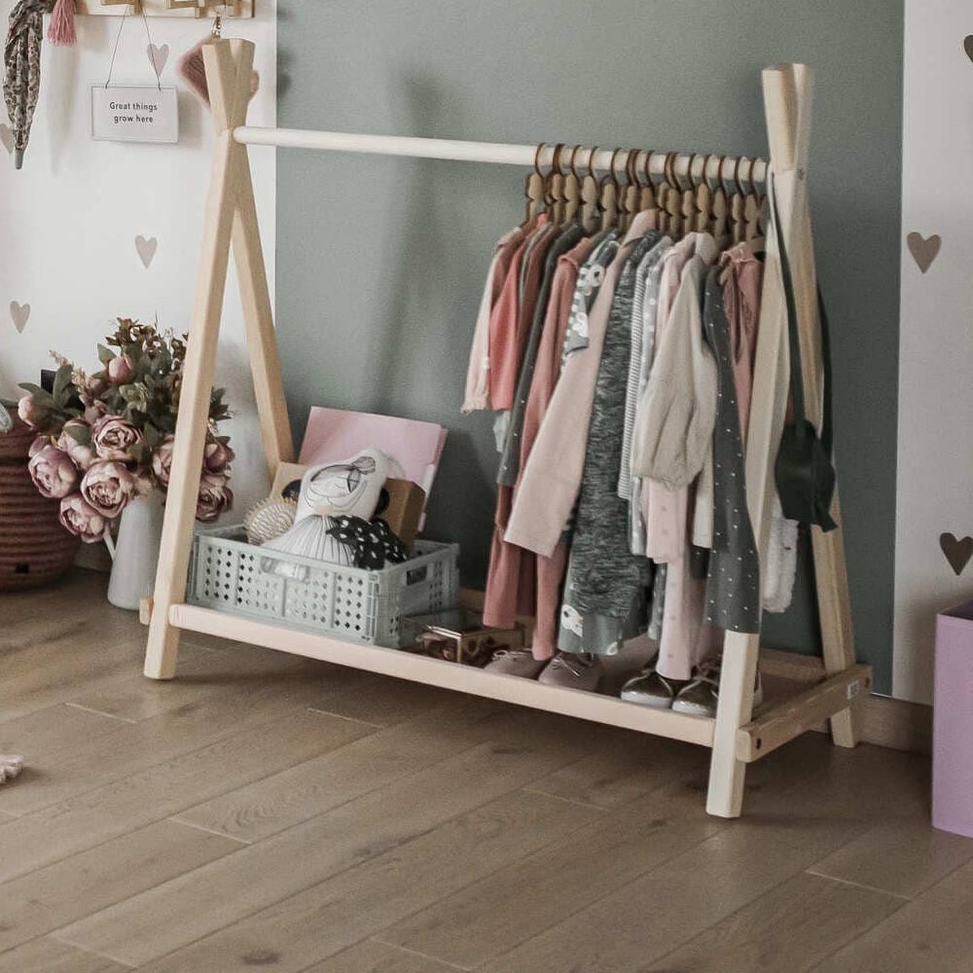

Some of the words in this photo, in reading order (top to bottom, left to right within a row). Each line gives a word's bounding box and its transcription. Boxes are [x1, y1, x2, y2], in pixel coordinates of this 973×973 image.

[109, 101, 131, 110] Great
[132, 102, 158, 113] things
[113, 115, 134, 124] grow
[135, 114, 154, 123] here
